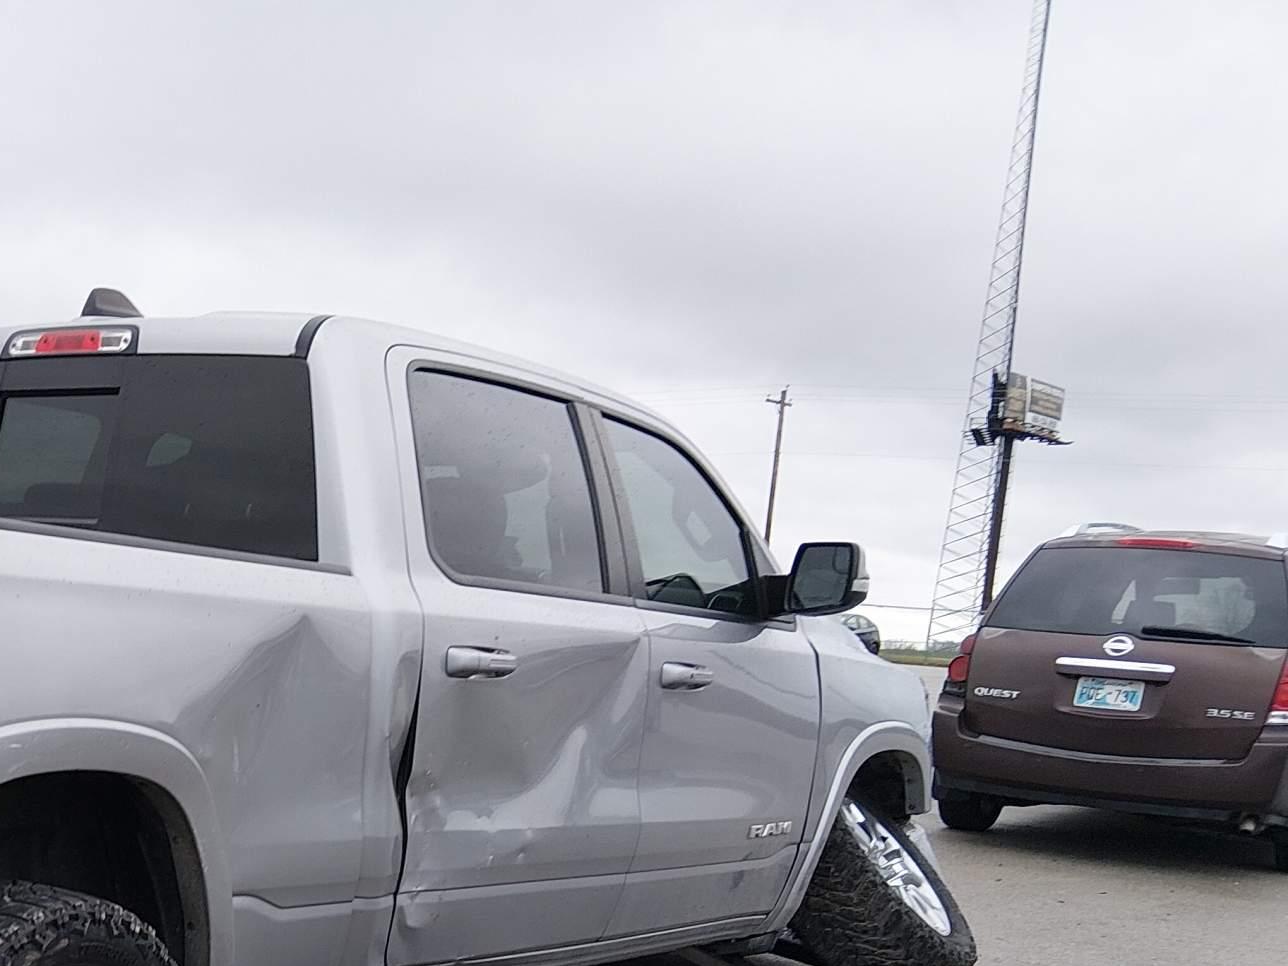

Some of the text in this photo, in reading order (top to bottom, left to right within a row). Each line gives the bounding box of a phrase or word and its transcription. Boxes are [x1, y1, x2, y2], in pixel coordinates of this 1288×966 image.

[974, 686, 1021, 699] QUEST
[1231, 710, 1255, 720] SE
[748, 821, 792, 838] RAM
